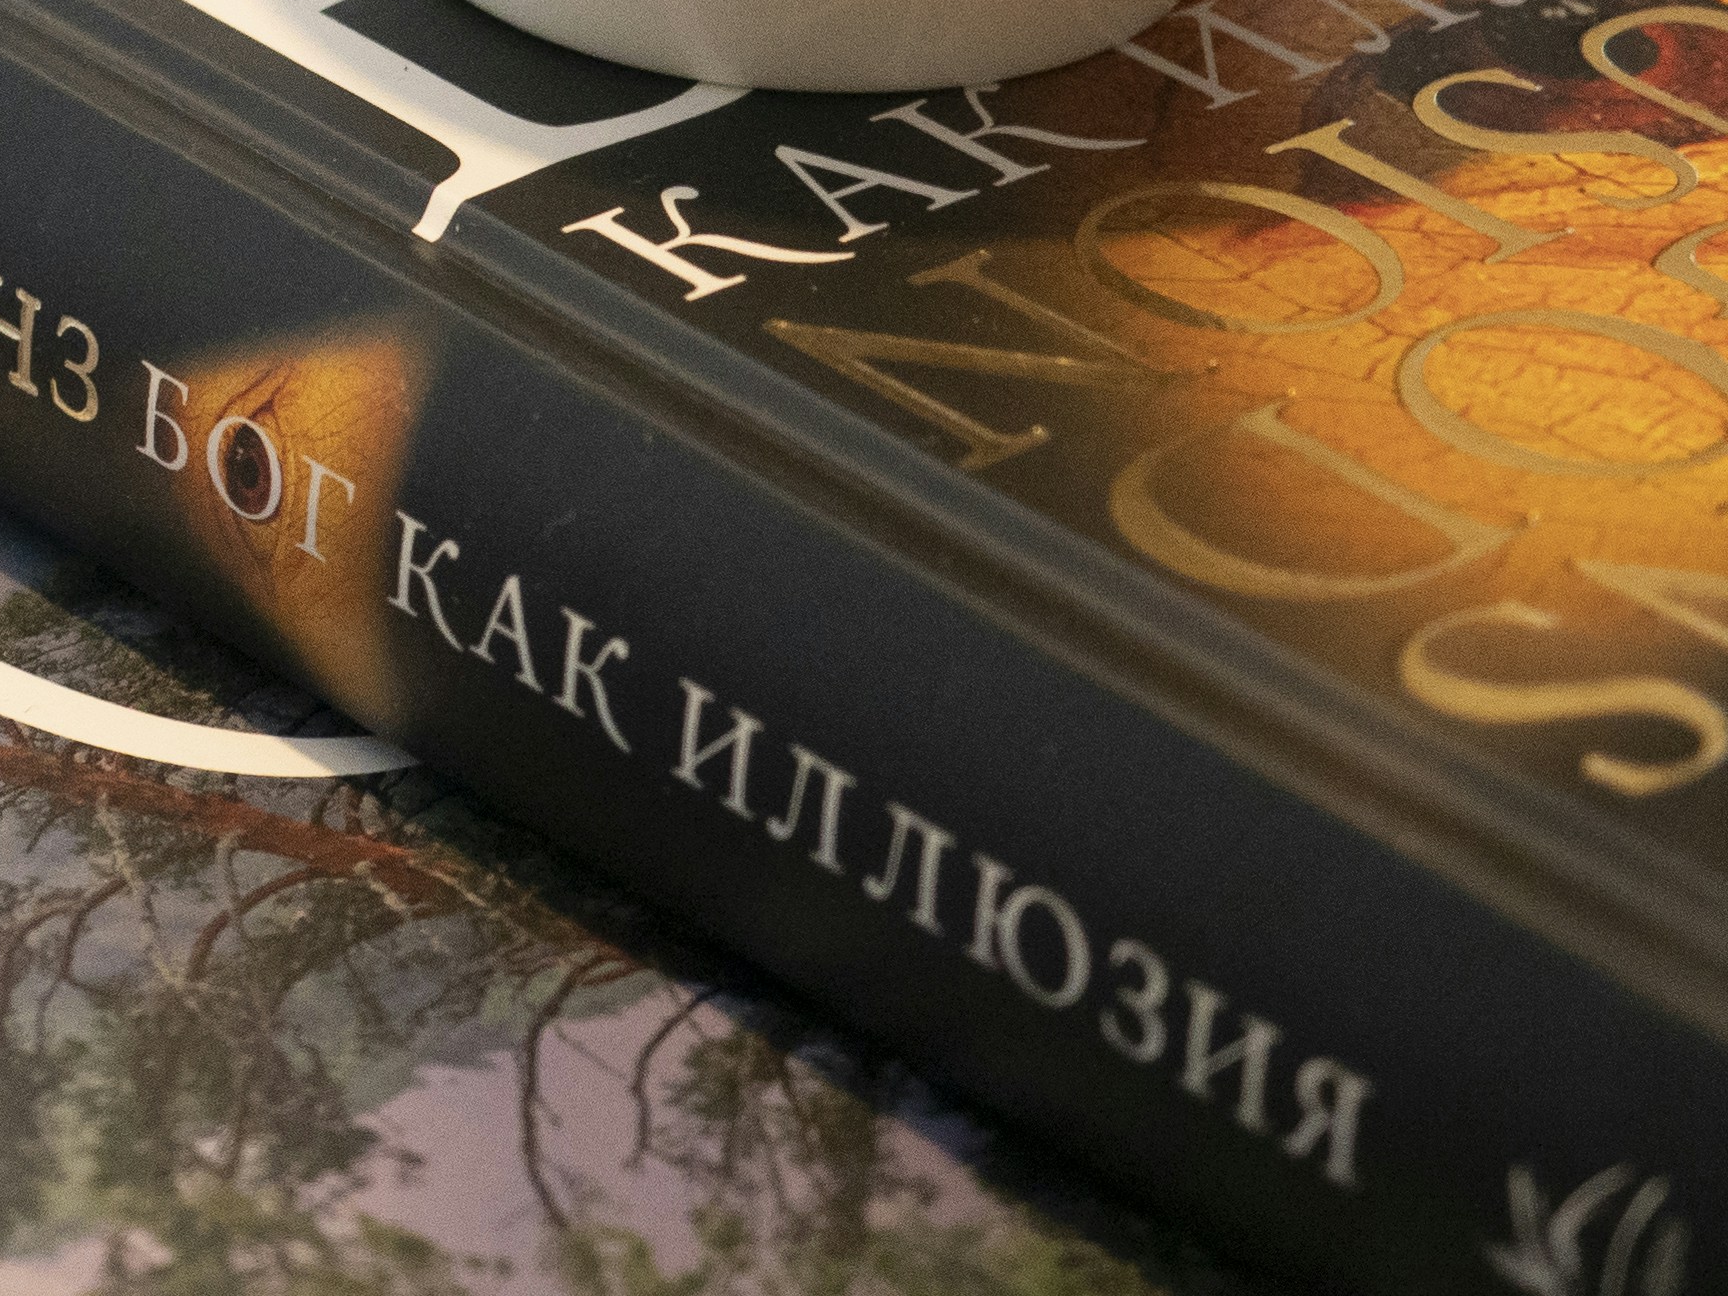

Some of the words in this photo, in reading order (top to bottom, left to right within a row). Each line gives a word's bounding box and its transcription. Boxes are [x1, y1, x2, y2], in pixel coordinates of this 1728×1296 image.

[562, 80, 1148, 303] КАК
[135, 360, 358, 562] БОГ
[386, 510, 632, 754] КАК
[670, 676, 1374, 1187] ИЛЛЮЗИЯ
